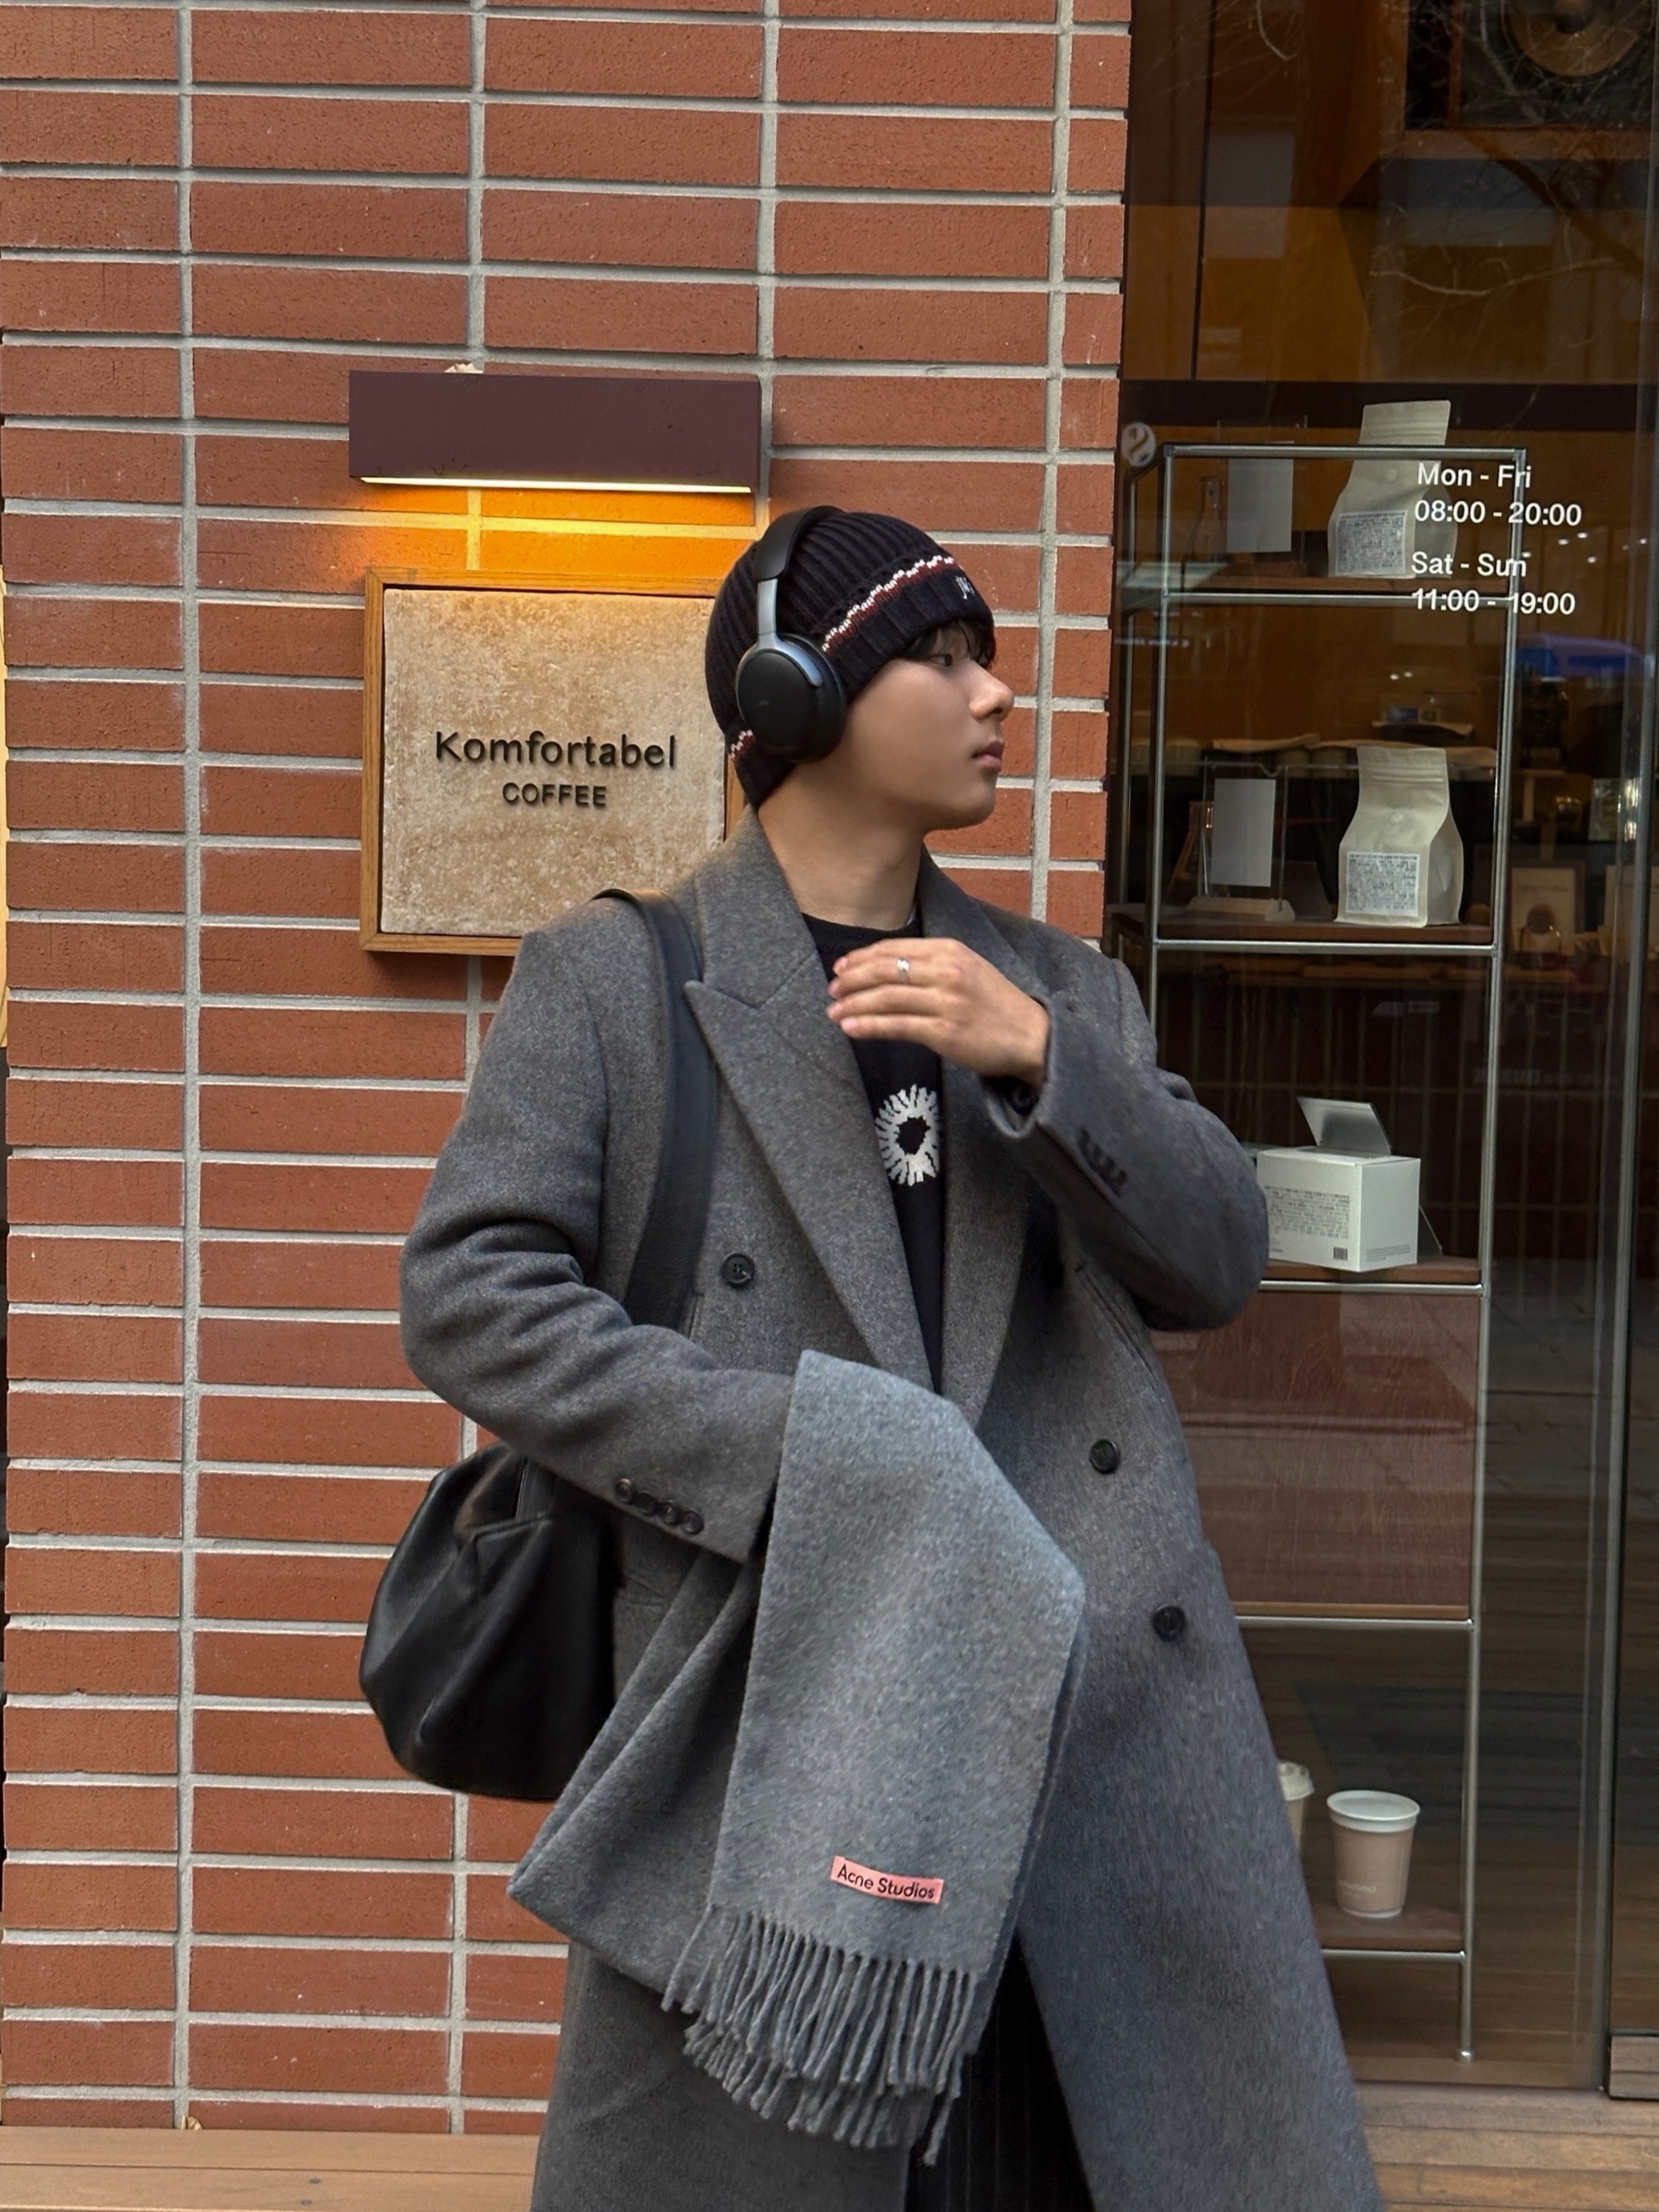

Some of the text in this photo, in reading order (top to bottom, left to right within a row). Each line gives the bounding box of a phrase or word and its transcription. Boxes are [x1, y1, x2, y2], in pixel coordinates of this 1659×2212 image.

[1417, 462, 1472, 486] Mon
[1497, 464, 1532, 488] Fri
[1414, 499, 1486, 524] 08:00
[1508, 502, 1582, 526] 20:00
[1411, 551, 1454, 575] Sat
[1476, 553, 1527, 577] Sun
[1412, 588, 1480, 612] 11:00
[1510, 591, 1576, 615] 19:00
[435, 730, 676, 769] Komfortabel
[501, 782, 608, 808] COFFEE
[837, 1863, 935, 1900] Acne Studios
